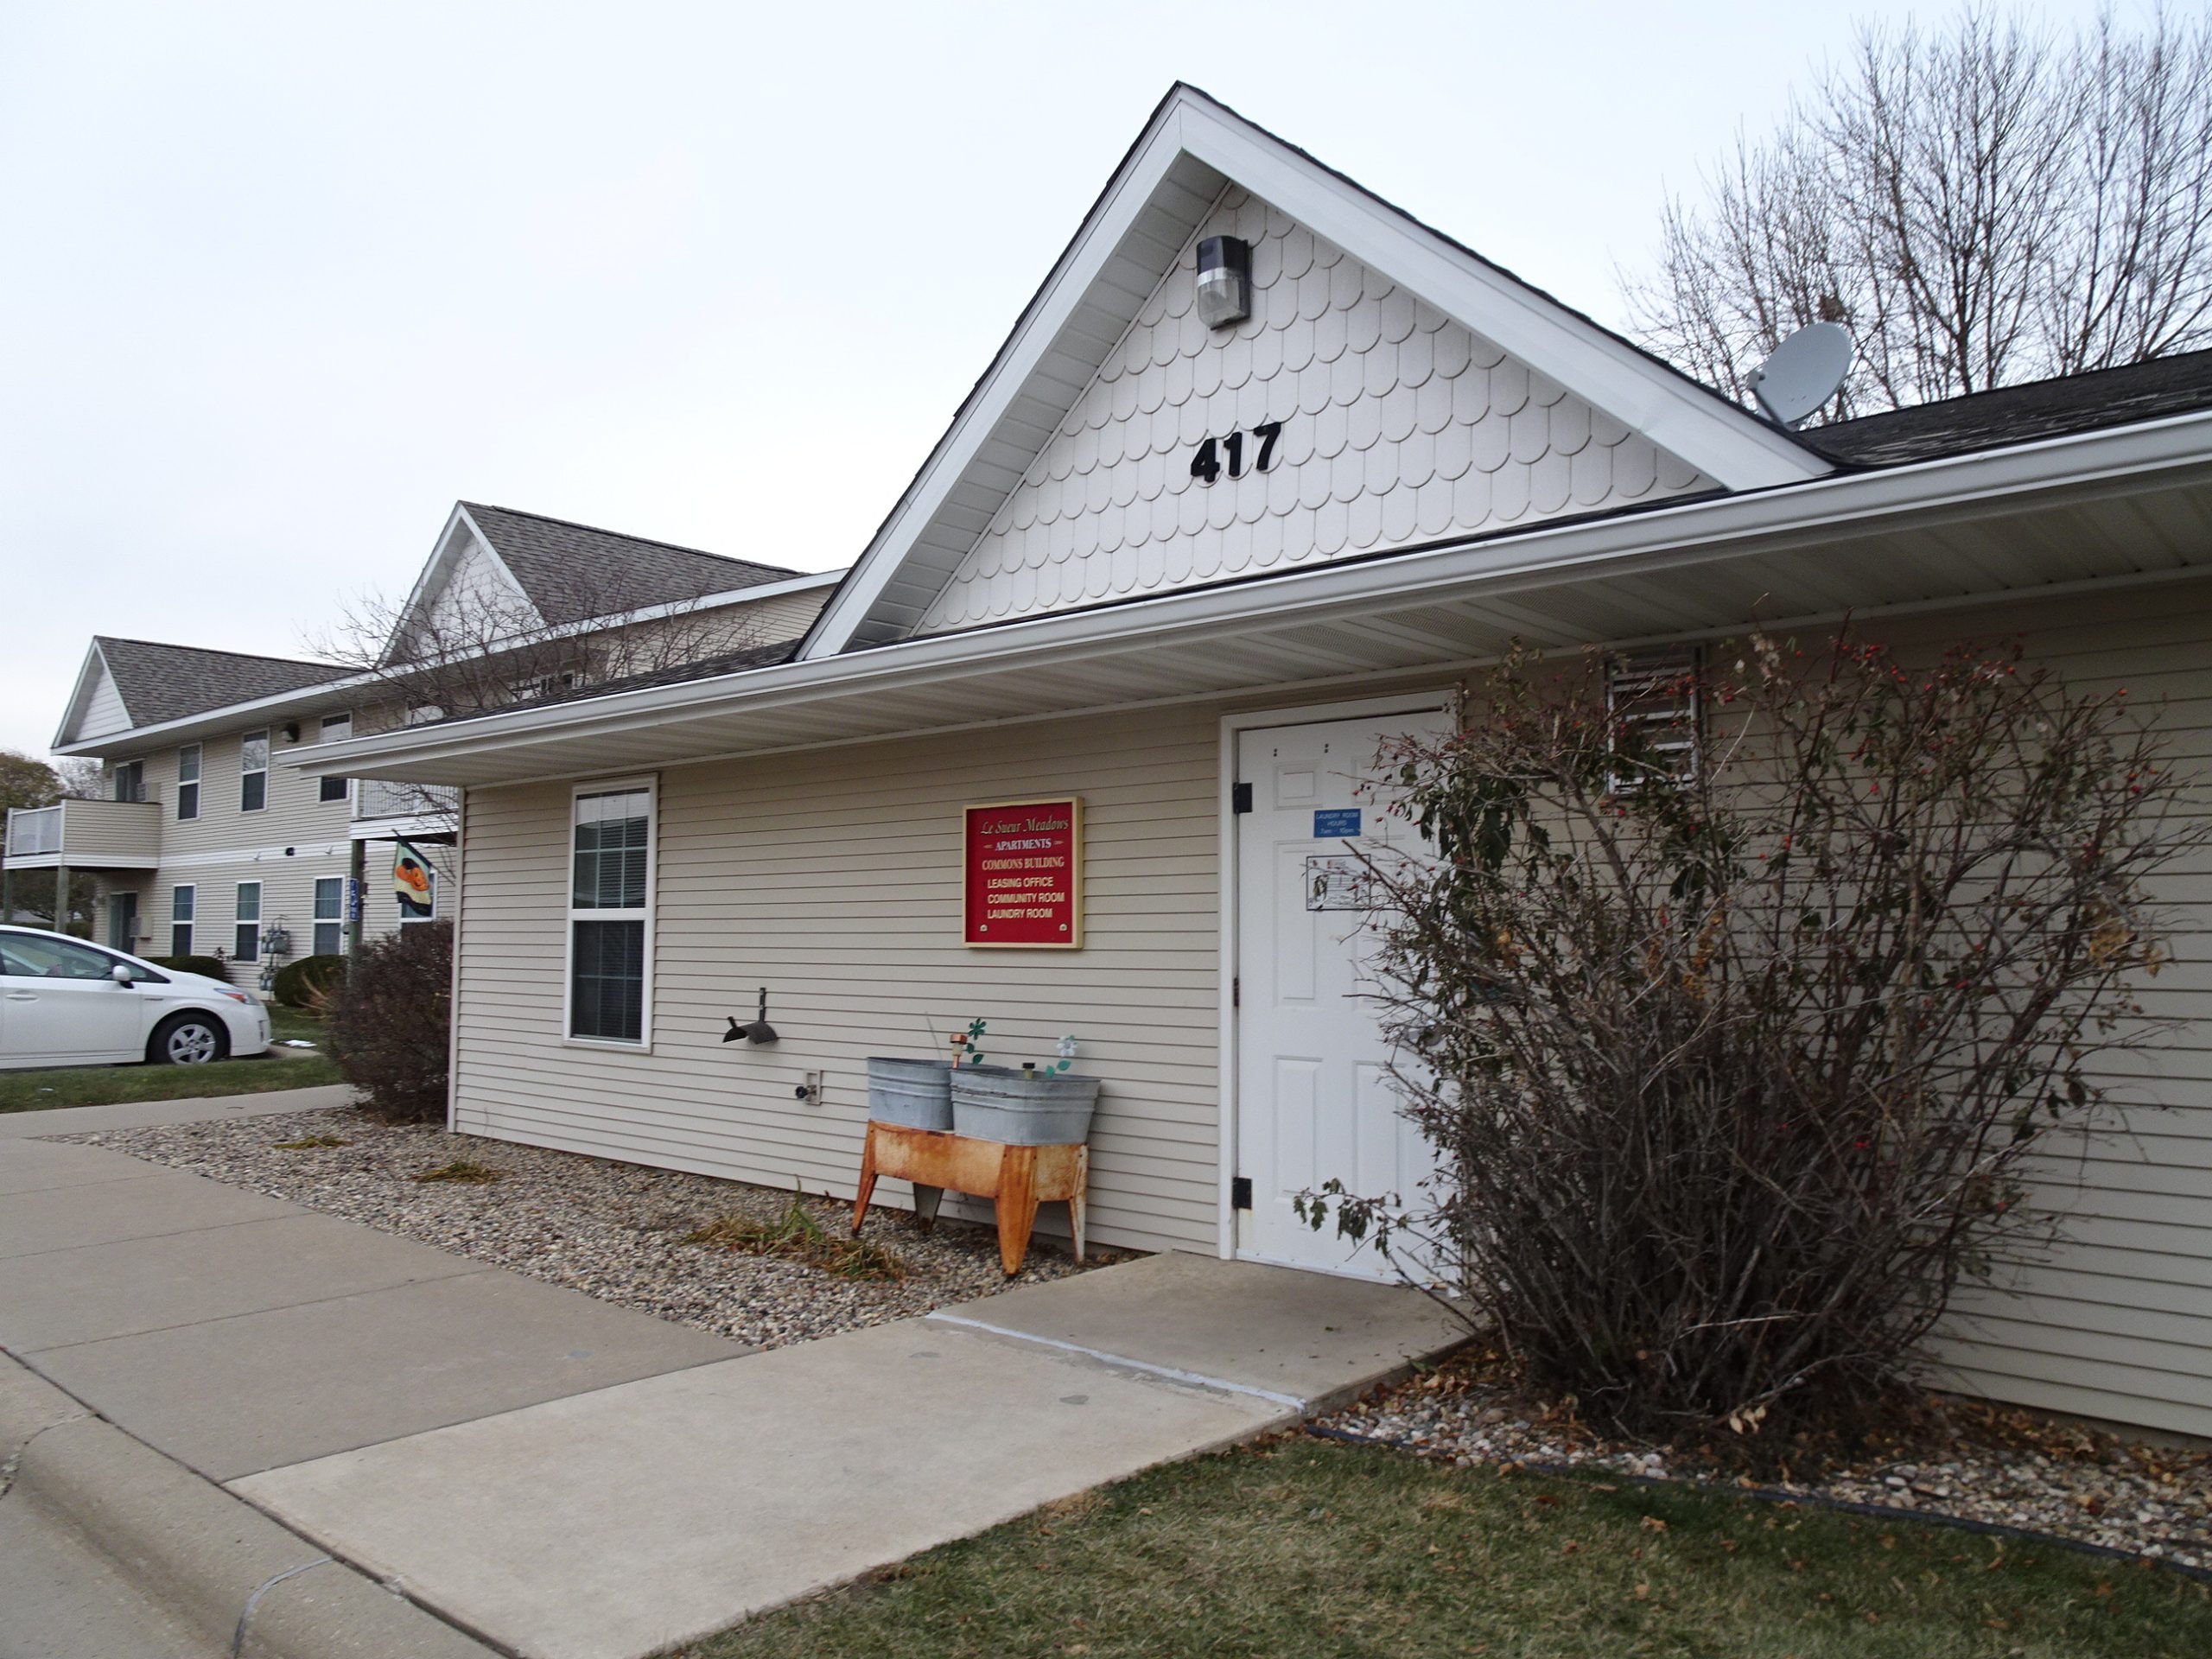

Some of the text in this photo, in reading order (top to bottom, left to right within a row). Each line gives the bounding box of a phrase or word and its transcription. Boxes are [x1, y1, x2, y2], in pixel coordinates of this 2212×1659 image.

[1190, 421, 1282, 483] 417
[980, 815, 1069, 835] Le Sueur Meadows
[995, 838, 1052, 851] APARTMENTS
[982, 856, 1065, 871] COMMONS BUILDING
[987, 876, 1054, 889] LEASING OFFICE
[987, 892, 1065, 905] COMMUNITY ROOM
[987, 908, 1053, 919] LAUNDRY ROOM
